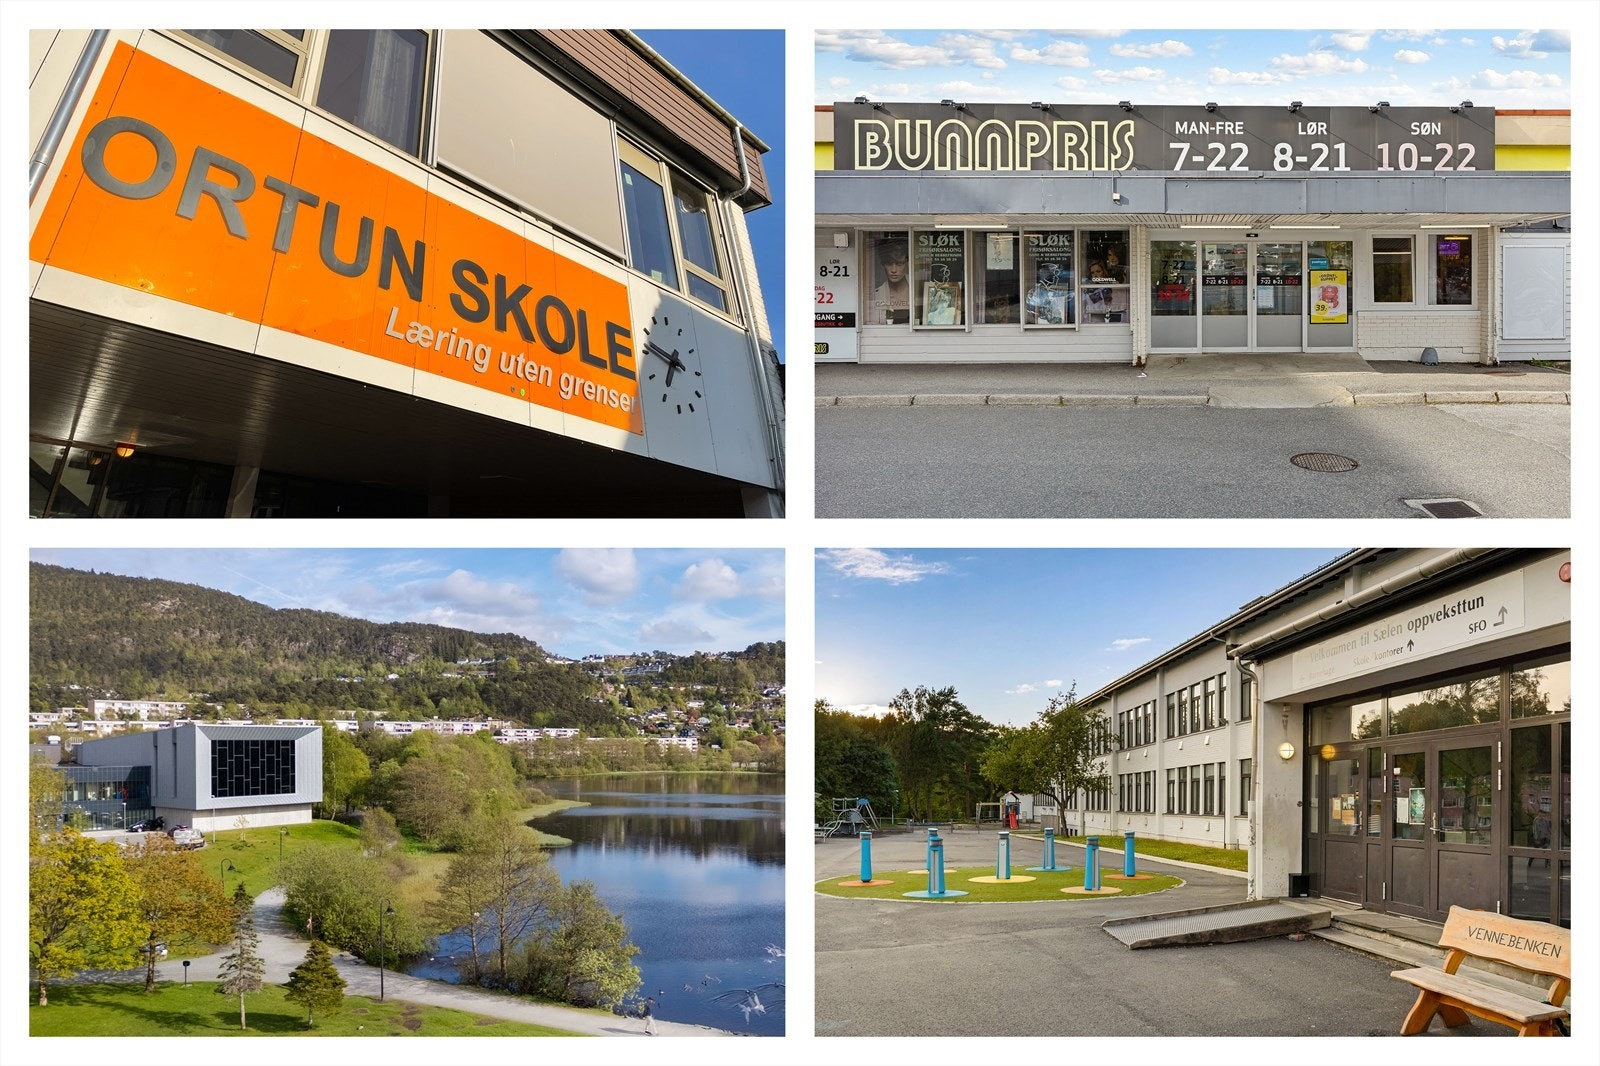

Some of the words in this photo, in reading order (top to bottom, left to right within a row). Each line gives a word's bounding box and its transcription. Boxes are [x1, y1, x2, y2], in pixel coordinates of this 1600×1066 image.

[1175, 121, 1244, 135] MAN-FRE
[1298, 121, 1328, 136] LØR
[1410, 121, 1442, 136] SØN
[854, 119, 1135, 171] BUNNPRIS
[1169, 142, 1249, 171] 7-22
[1273, 142, 1351, 171] 8-21
[1377, 142, 1476, 171] 10-22
[918, 233, 960, 247] SLØK
[1028, 233, 1070, 247] SLØK
[81, 116, 425, 302] ORTUN
[449, 259, 637, 381] SKOLE
[819, 265, 850, 277] 8-21
[1161, 260, 1186, 270] 7-22
[1162, 275, 1186, 285] 8-21
[385, 307, 492, 373] Læring
[499, 351, 553, 388] uten
[559, 371, 638, 414] grenser
[1360, 632, 1370, 647] til
[1373, 624, 1403, 643] Sælen
[1407, 595, 1484, 633] oppveksttun
[1468, 619, 1487, 634] SFO
[1468, 925, 1562, 958] VENNEBENKEN
